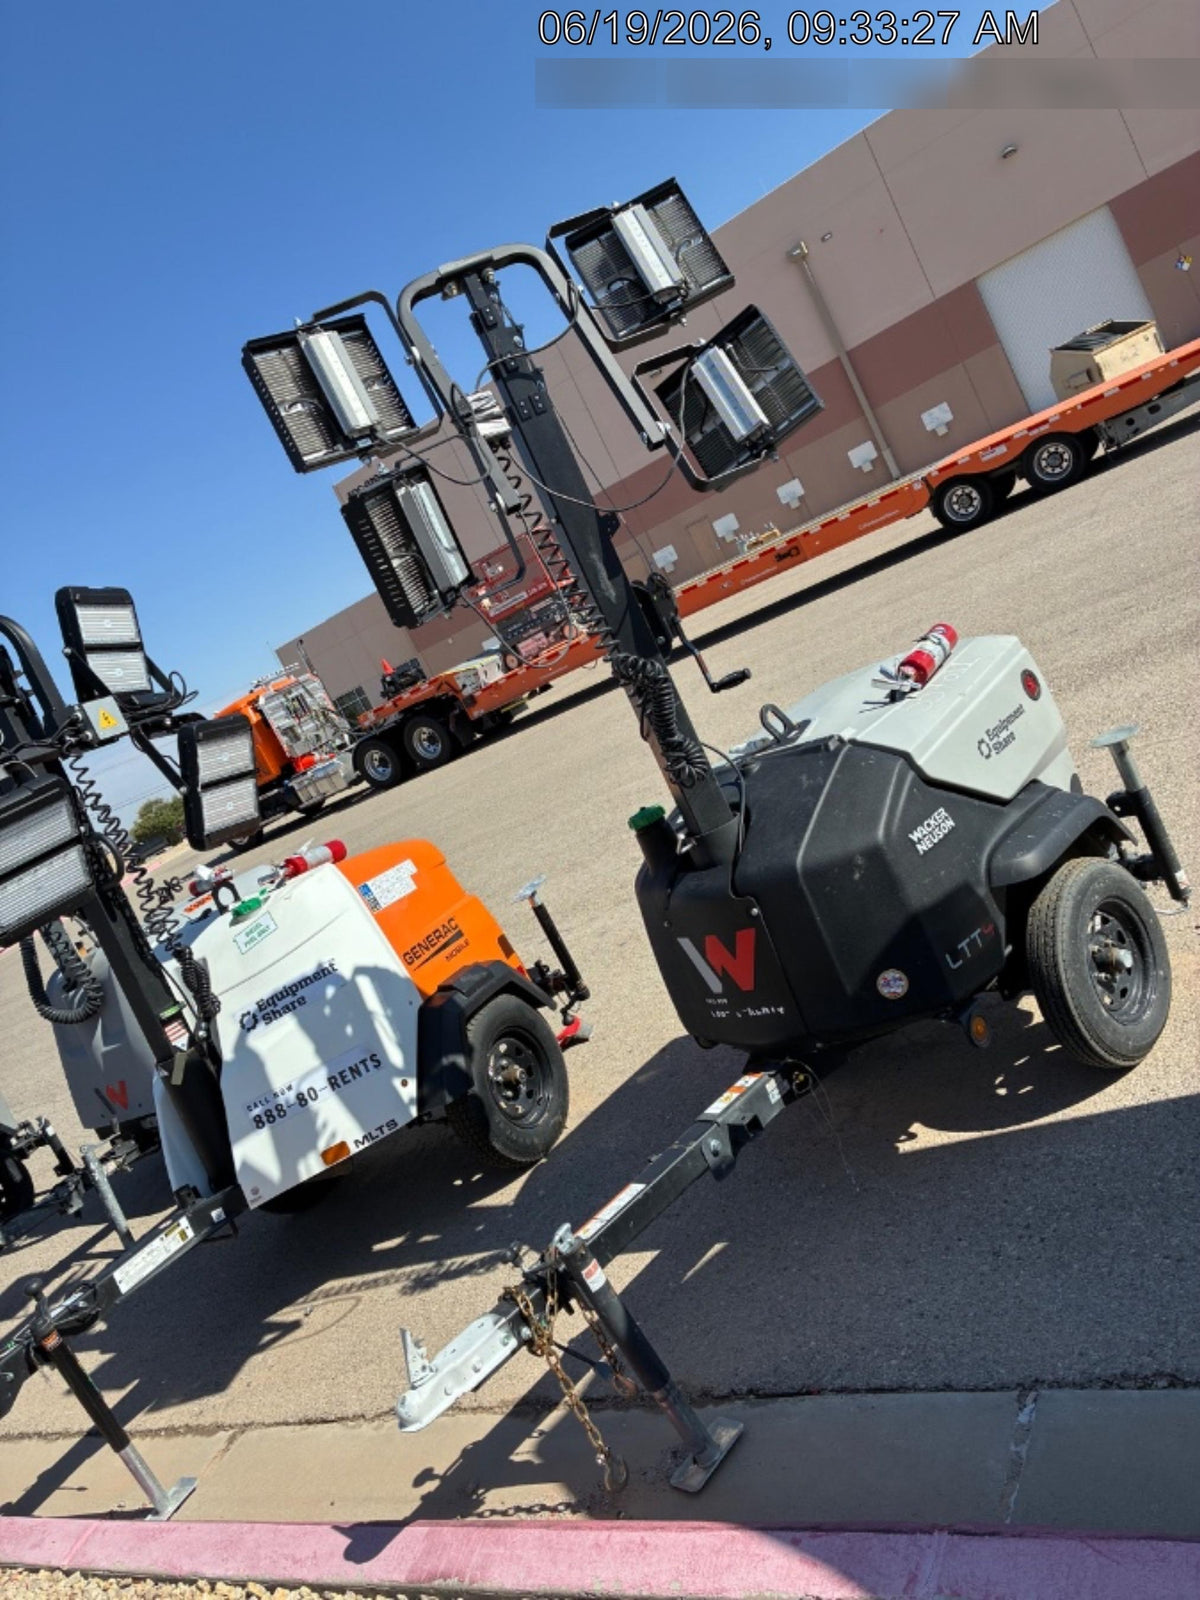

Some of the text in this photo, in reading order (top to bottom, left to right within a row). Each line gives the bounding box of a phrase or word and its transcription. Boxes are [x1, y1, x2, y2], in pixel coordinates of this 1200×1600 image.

[985, 703, 1025, 742] Equipment
[992, 731, 1016, 754] Share
[908, 806, 949, 842] WACKER
[915, 816, 956, 855] NEUSON
[403, 917, 459, 966] GENERAC
[256, 958, 338, 1013] Equipment
[262, 995, 307, 1026] Share
[247, 1096, 270, 1112] CALL
[353, 1118, 399, 1149] MLTS
